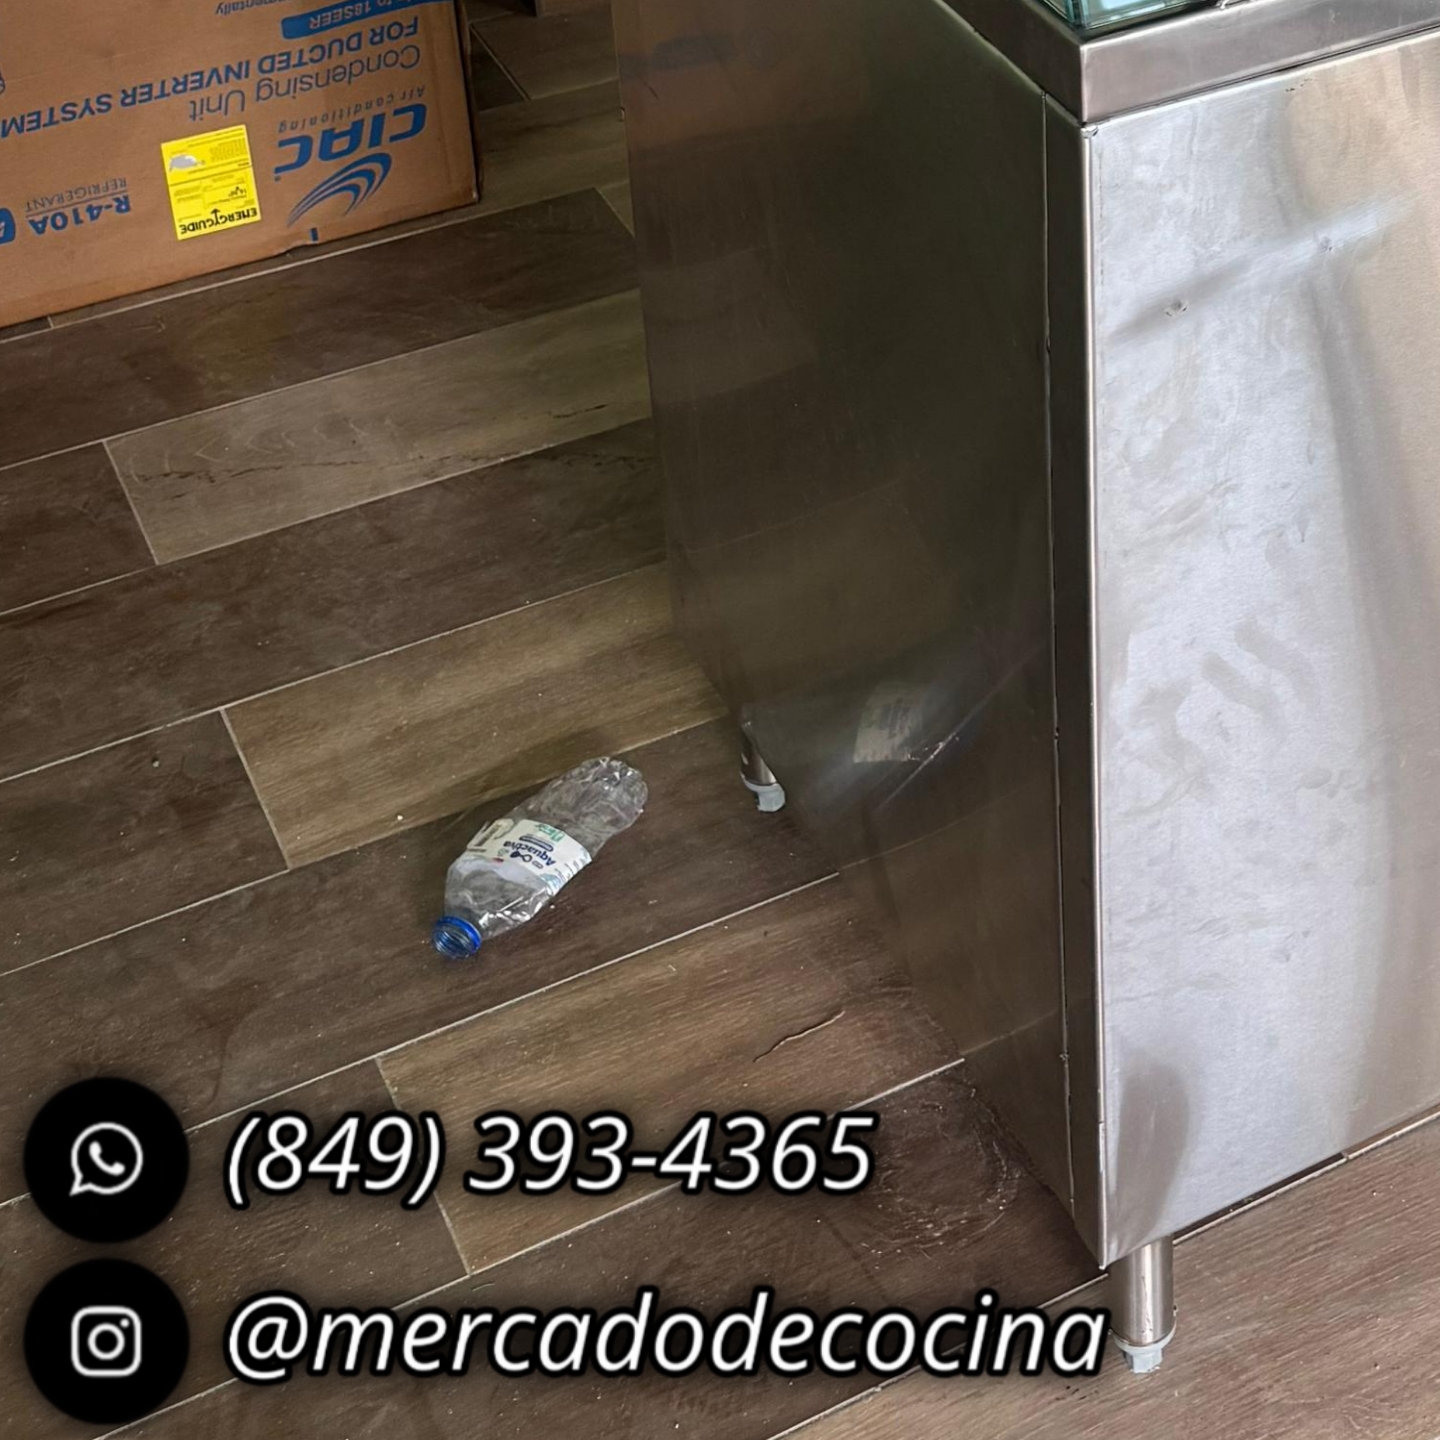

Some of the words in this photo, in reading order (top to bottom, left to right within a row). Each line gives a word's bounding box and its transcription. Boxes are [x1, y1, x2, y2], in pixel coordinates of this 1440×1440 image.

[309, 0, 372, 30] 18SEER
[368, 16, 418, 46] FOR
[256, 30, 363, 75] DUCTED
[119, 60, 250, 108] INVERTER
[255, 44, 420, 102] Condensing
[189, 89, 246, 121] Unit
[401, 85, 425, 101] Air
[0, 93, 112, 138] SYSTEM
[278, 94, 394, 133] conditioning
[274, 103, 428, 174] CIAC
[25, 177, 127, 211] REFRIGERANT
[27, 194, 131, 235] R-410A
[503, 840, 556, 866] Aquactiva
